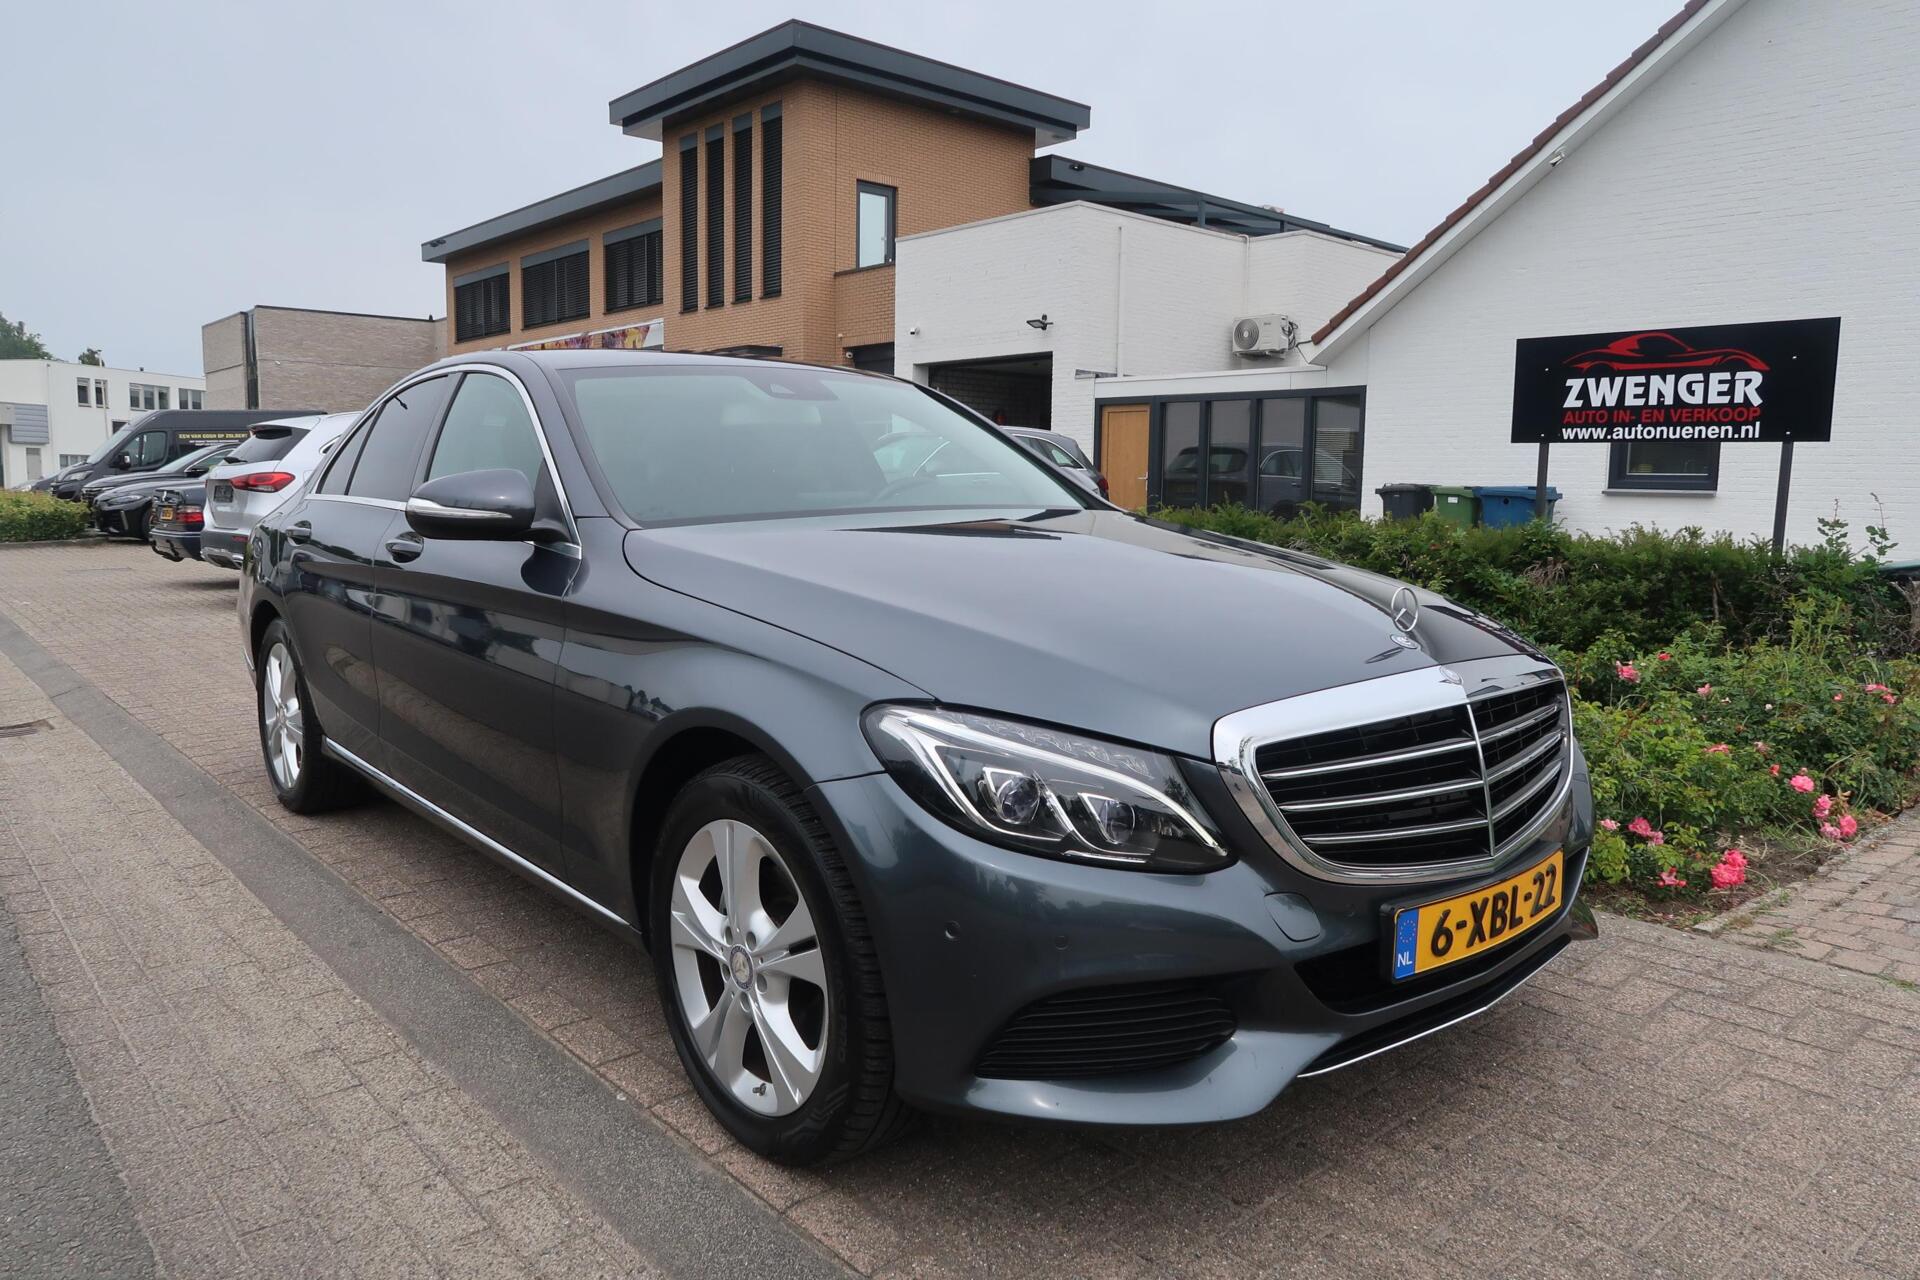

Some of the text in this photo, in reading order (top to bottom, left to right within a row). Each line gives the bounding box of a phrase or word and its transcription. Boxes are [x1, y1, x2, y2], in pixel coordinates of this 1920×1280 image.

[1563, 371, 1763, 407] ZWENGER
[1564, 406, 1761, 424] AUTO IN- EN VERKOOP
[1562, 422, 1760, 440] www.autonuenen.nl
[1431, 864, 1557, 957] 6-XBL-22
[1397, 953, 1412, 967] NL
